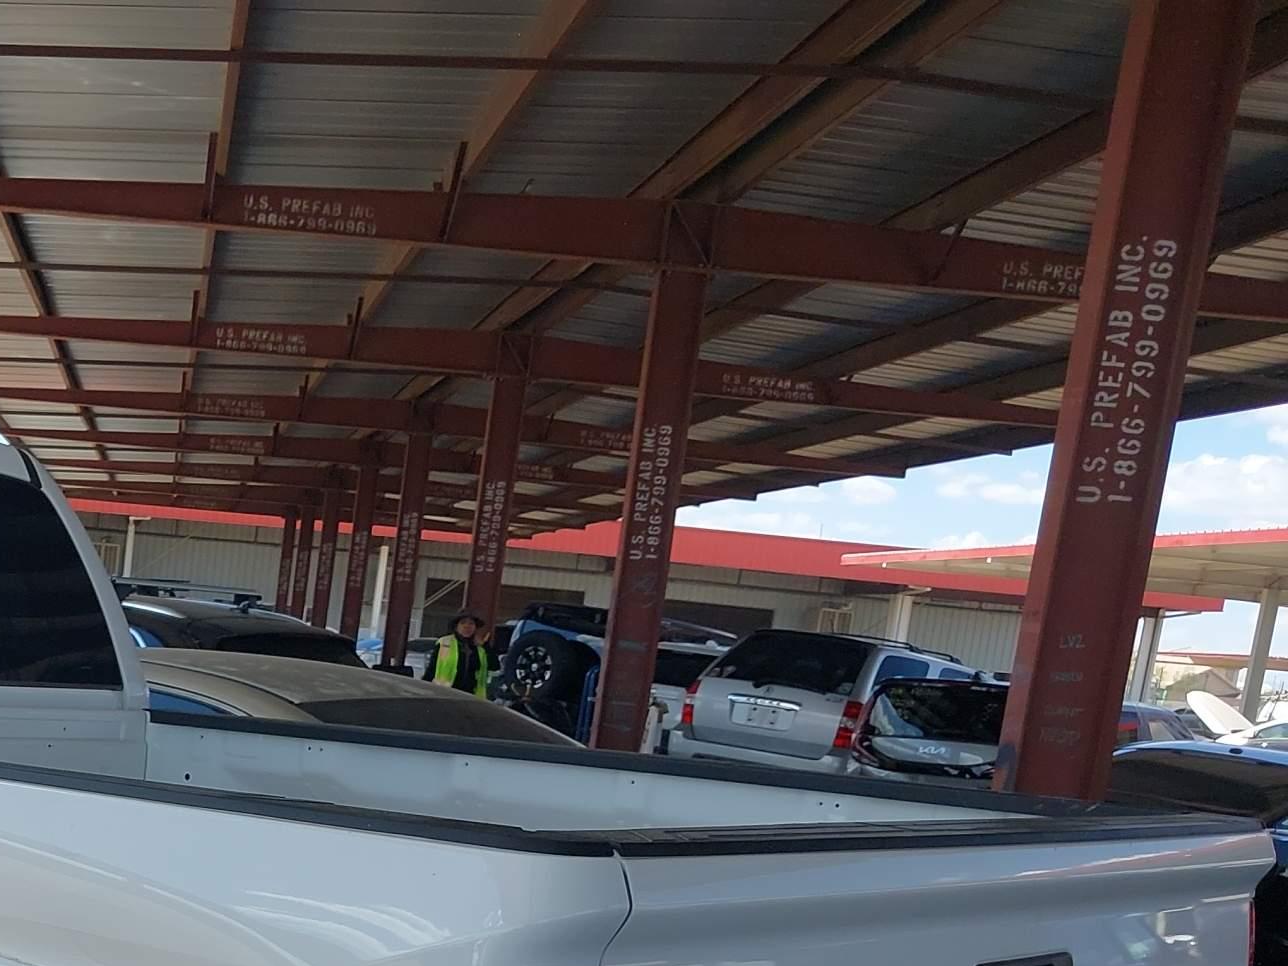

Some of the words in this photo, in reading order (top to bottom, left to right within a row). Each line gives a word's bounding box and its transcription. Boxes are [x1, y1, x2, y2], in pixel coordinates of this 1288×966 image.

[244, 194, 273, 211] U.S.
[282, 198, 342, 216] PREFAB
[1114, 236, 1148, 292] INC.
[1091, 310, 1133, 428] PREFAB
[1107, 239, 1177, 502] 1-866-799-0969
[634, 461, 653, 521] PREFAB
[645, 424, 672, 559] 1-866-799-0969
[1076, 448, 1110, 502] U.S.
[629, 531, 645, 560] U.S.
